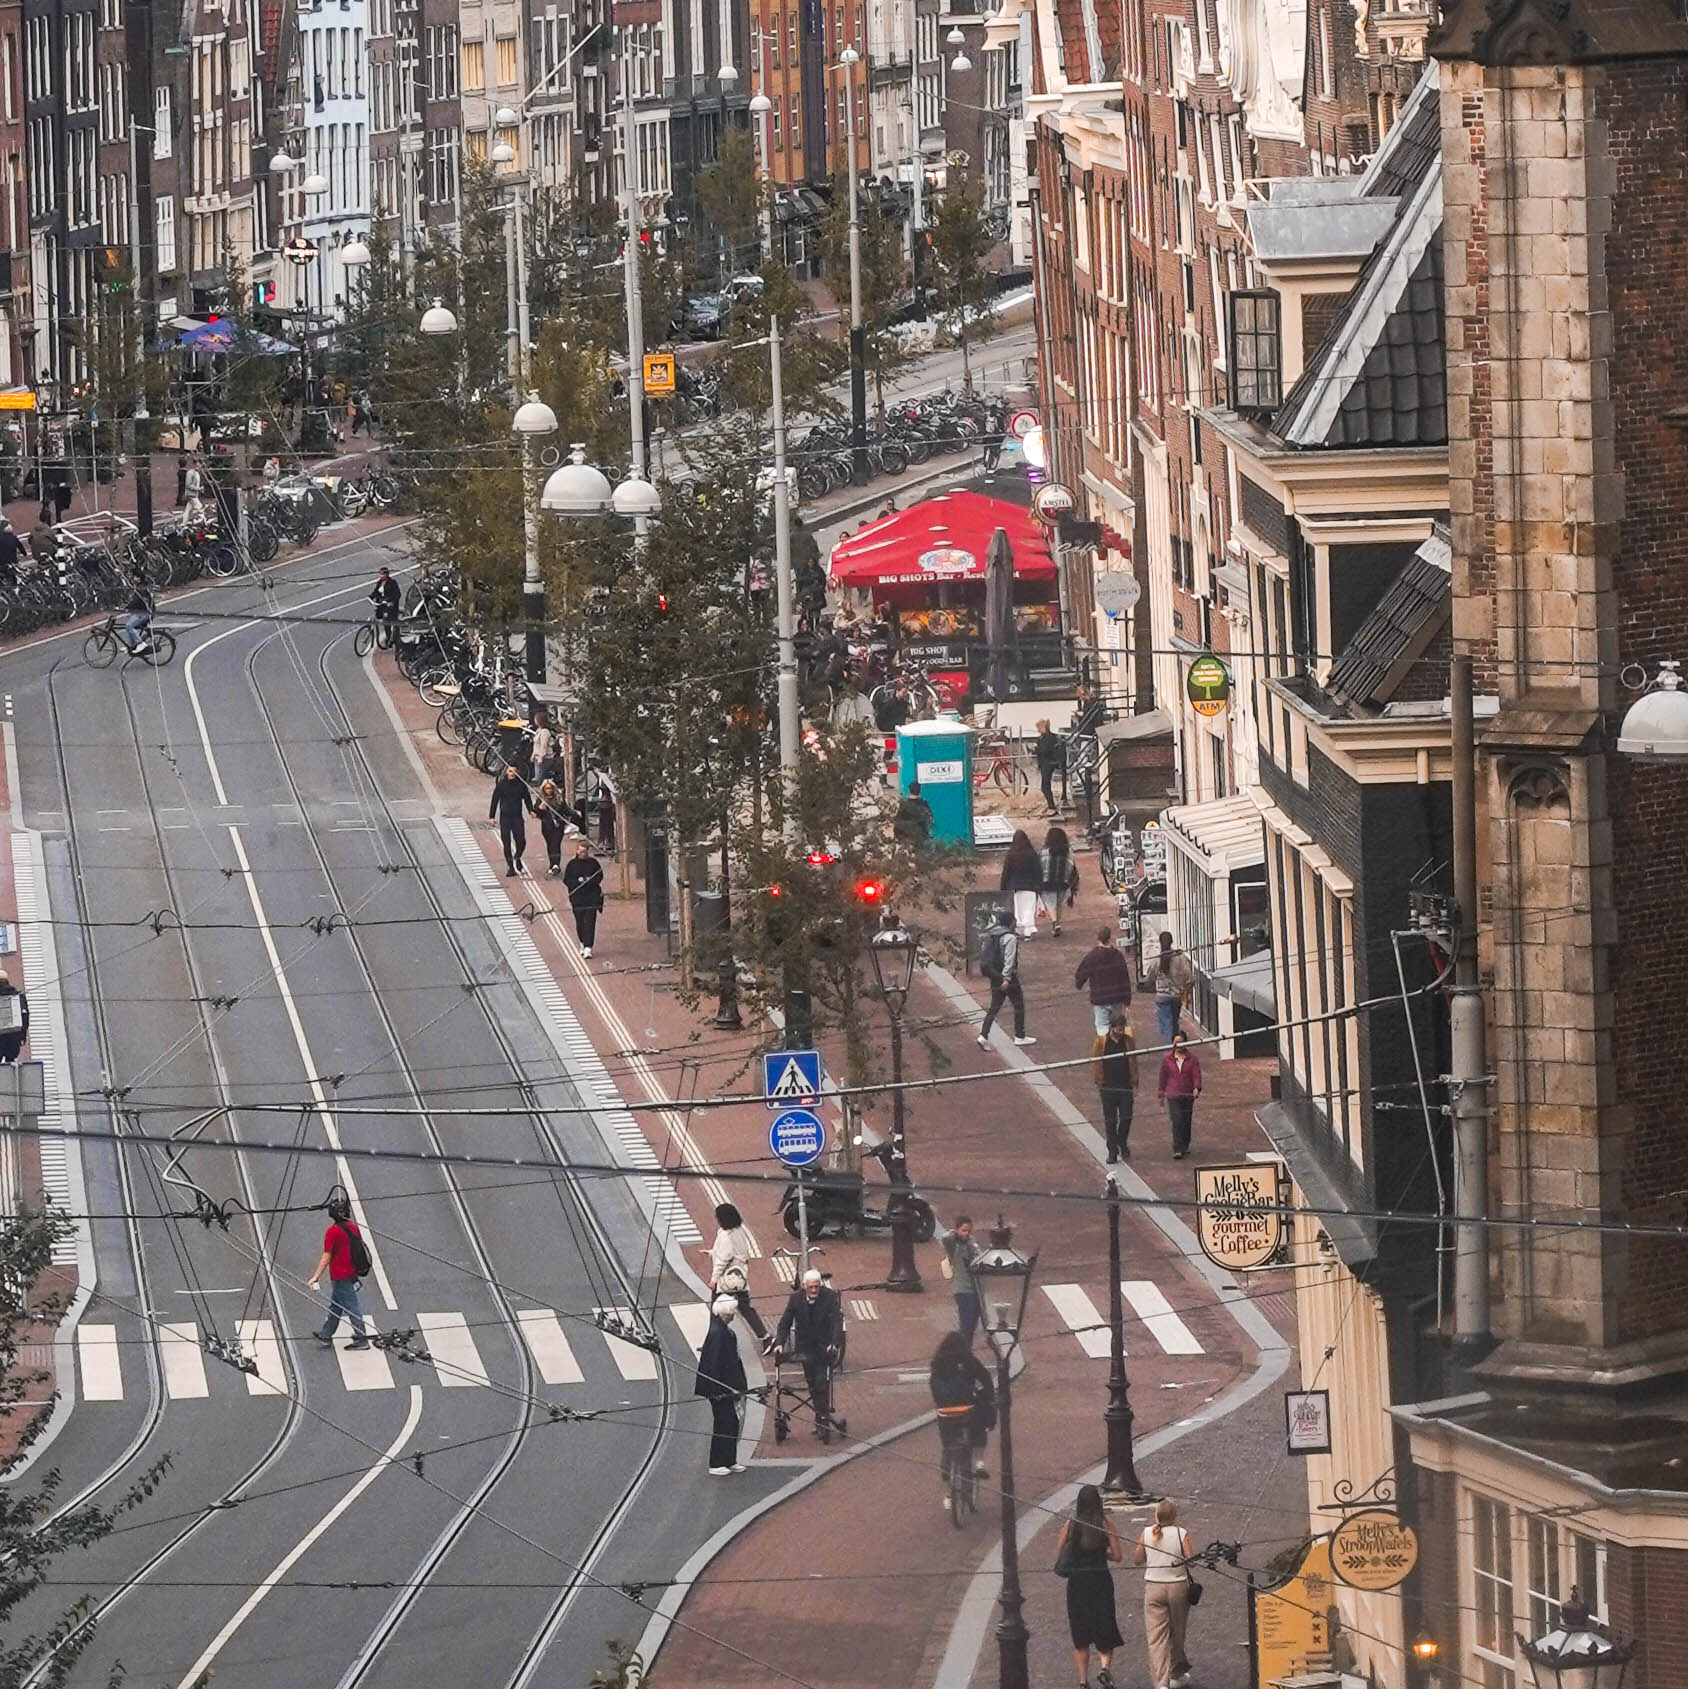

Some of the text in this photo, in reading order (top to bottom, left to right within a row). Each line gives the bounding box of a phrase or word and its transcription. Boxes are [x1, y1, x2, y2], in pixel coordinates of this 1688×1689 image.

[878, 575, 898, 584] BIG
[899, 572, 935, 582] SHOTS
[929, 765, 951, 774] DIXI
[1213, 1173, 1260, 1198] Melly's
[1212, 1218, 1271, 1239] gourmet
[1220, 1234, 1263, 1254] Coffee
